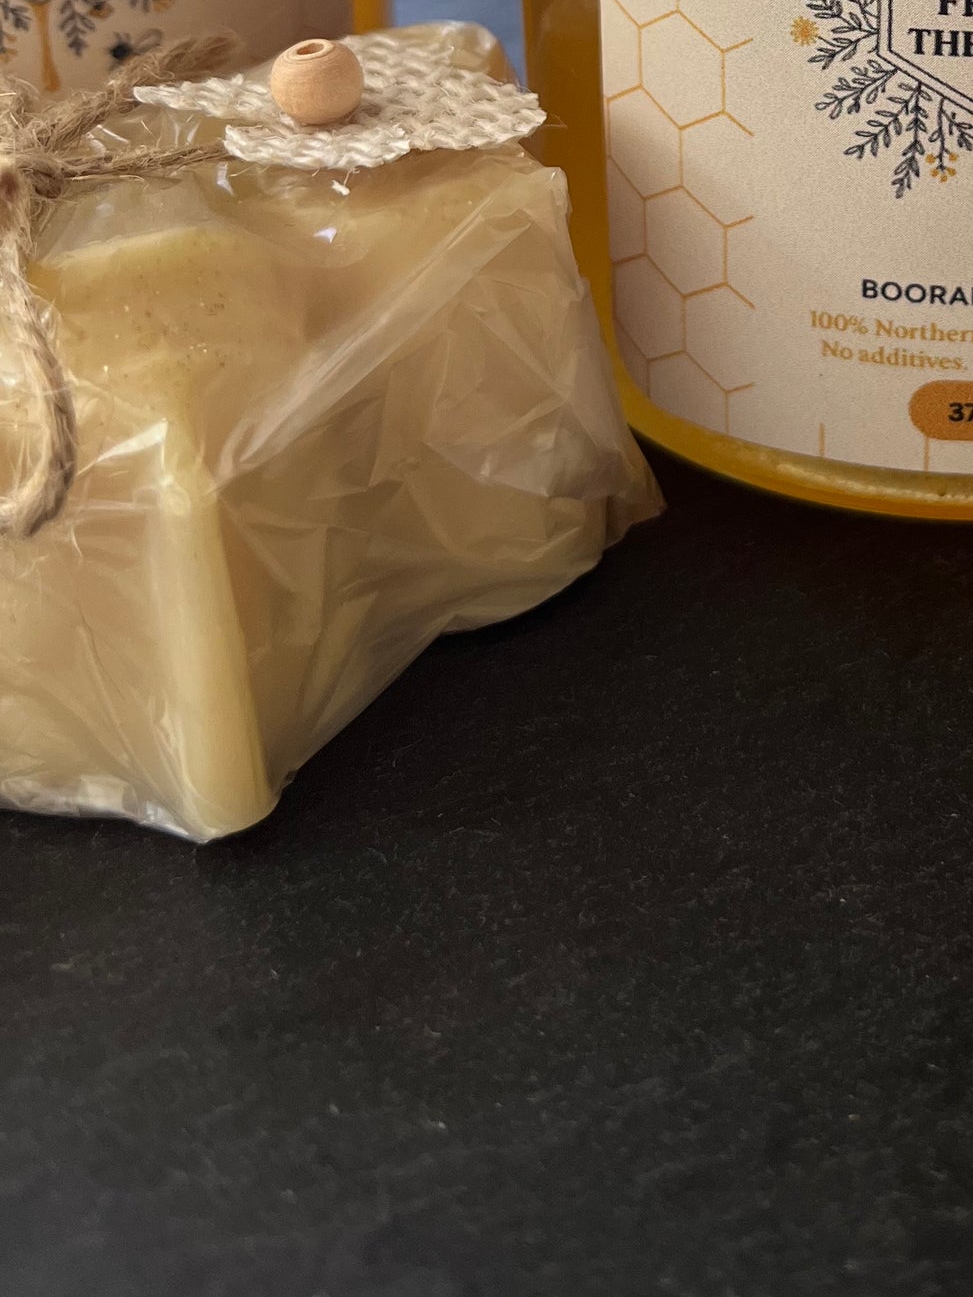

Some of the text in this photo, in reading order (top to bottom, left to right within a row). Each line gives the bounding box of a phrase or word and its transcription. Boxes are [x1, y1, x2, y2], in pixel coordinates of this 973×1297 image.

[810, 310, 868, 334] 100%
[821, 339, 853, 360] No
[858, 345, 968, 371] additives.
